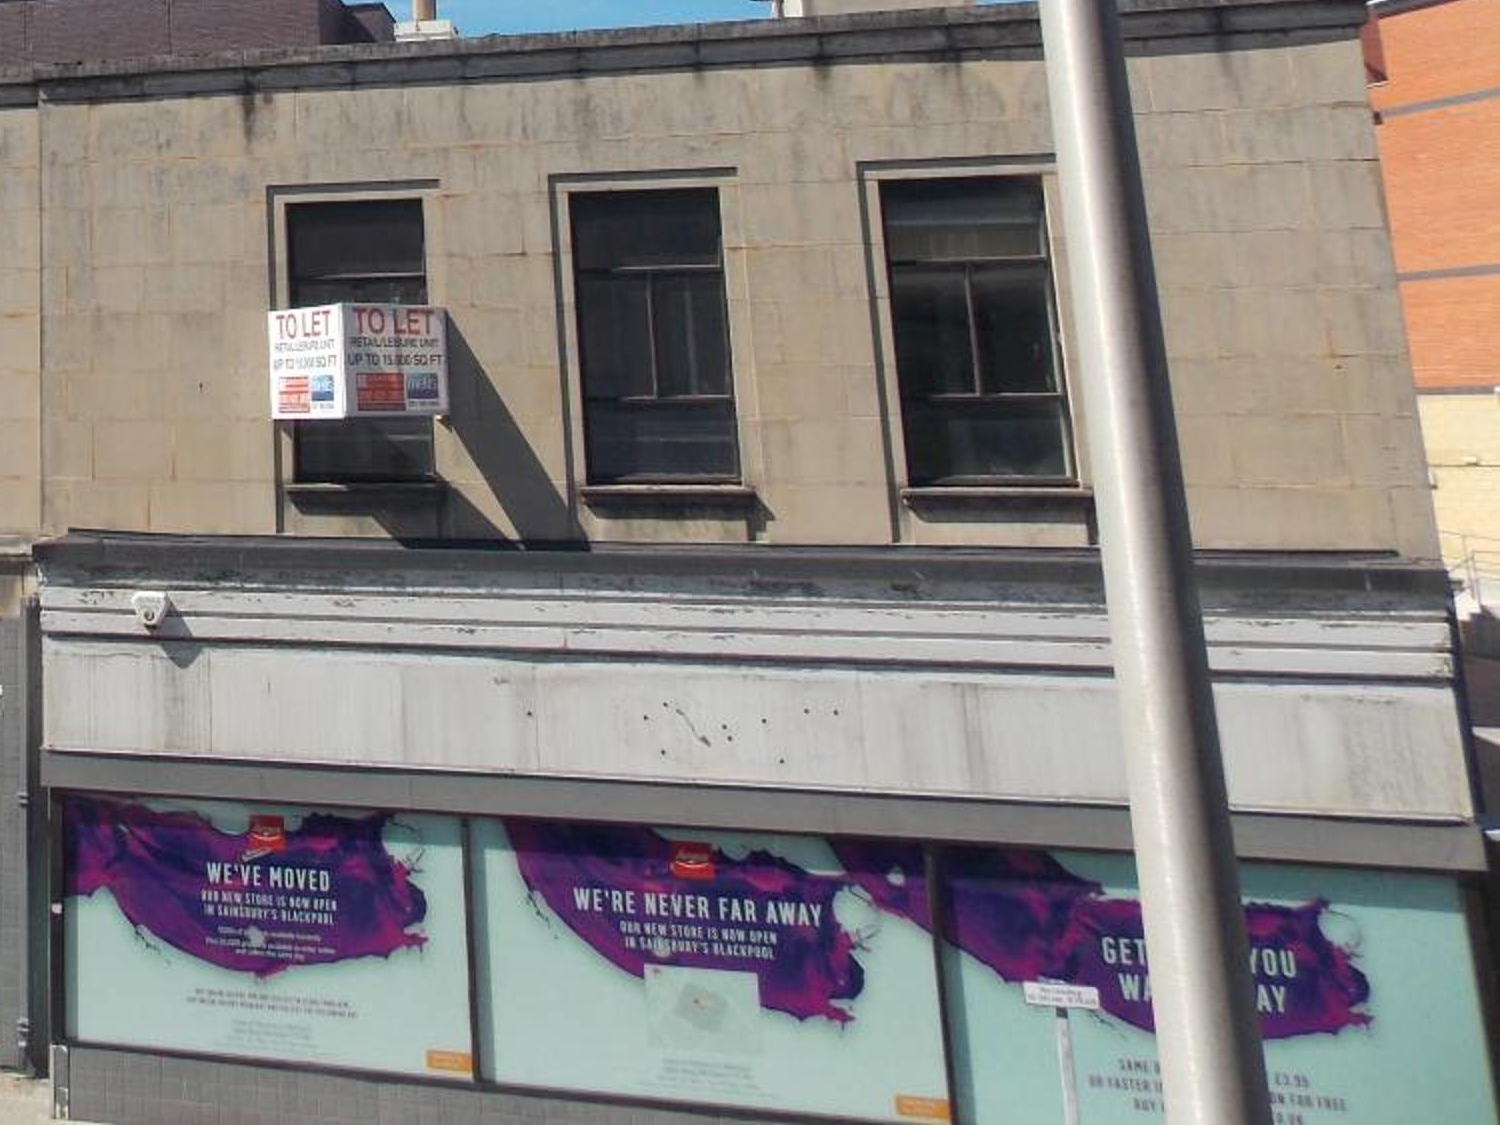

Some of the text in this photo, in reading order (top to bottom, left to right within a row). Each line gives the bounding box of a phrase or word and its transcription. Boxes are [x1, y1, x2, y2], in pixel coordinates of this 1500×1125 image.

[276, 309, 330, 339] TO LET
[352, 308, 435, 335] TO LET
[348, 353, 362, 365] UP
[366, 354, 380, 366] TO
[412, 355, 428, 366] SQ
[430, 355, 442, 365] FT
[206, 862, 330, 892] WE'VE MOVED
[574, 887, 822, 928] WE'RE NEVER FAR AWAY
[619, 920, 778, 945] OUR NEW STORE IS NOW OPEN
[625, 936, 636, 949] IN
[713, 942, 775, 960] BLACKPOOL
[1102, 937, 1147, 966] GET
[1118, 1057, 1148, 1072] SAME
[1108, 1077, 1148, 1093] FASTER
[1317, 1095, 1348, 1112] FREE
